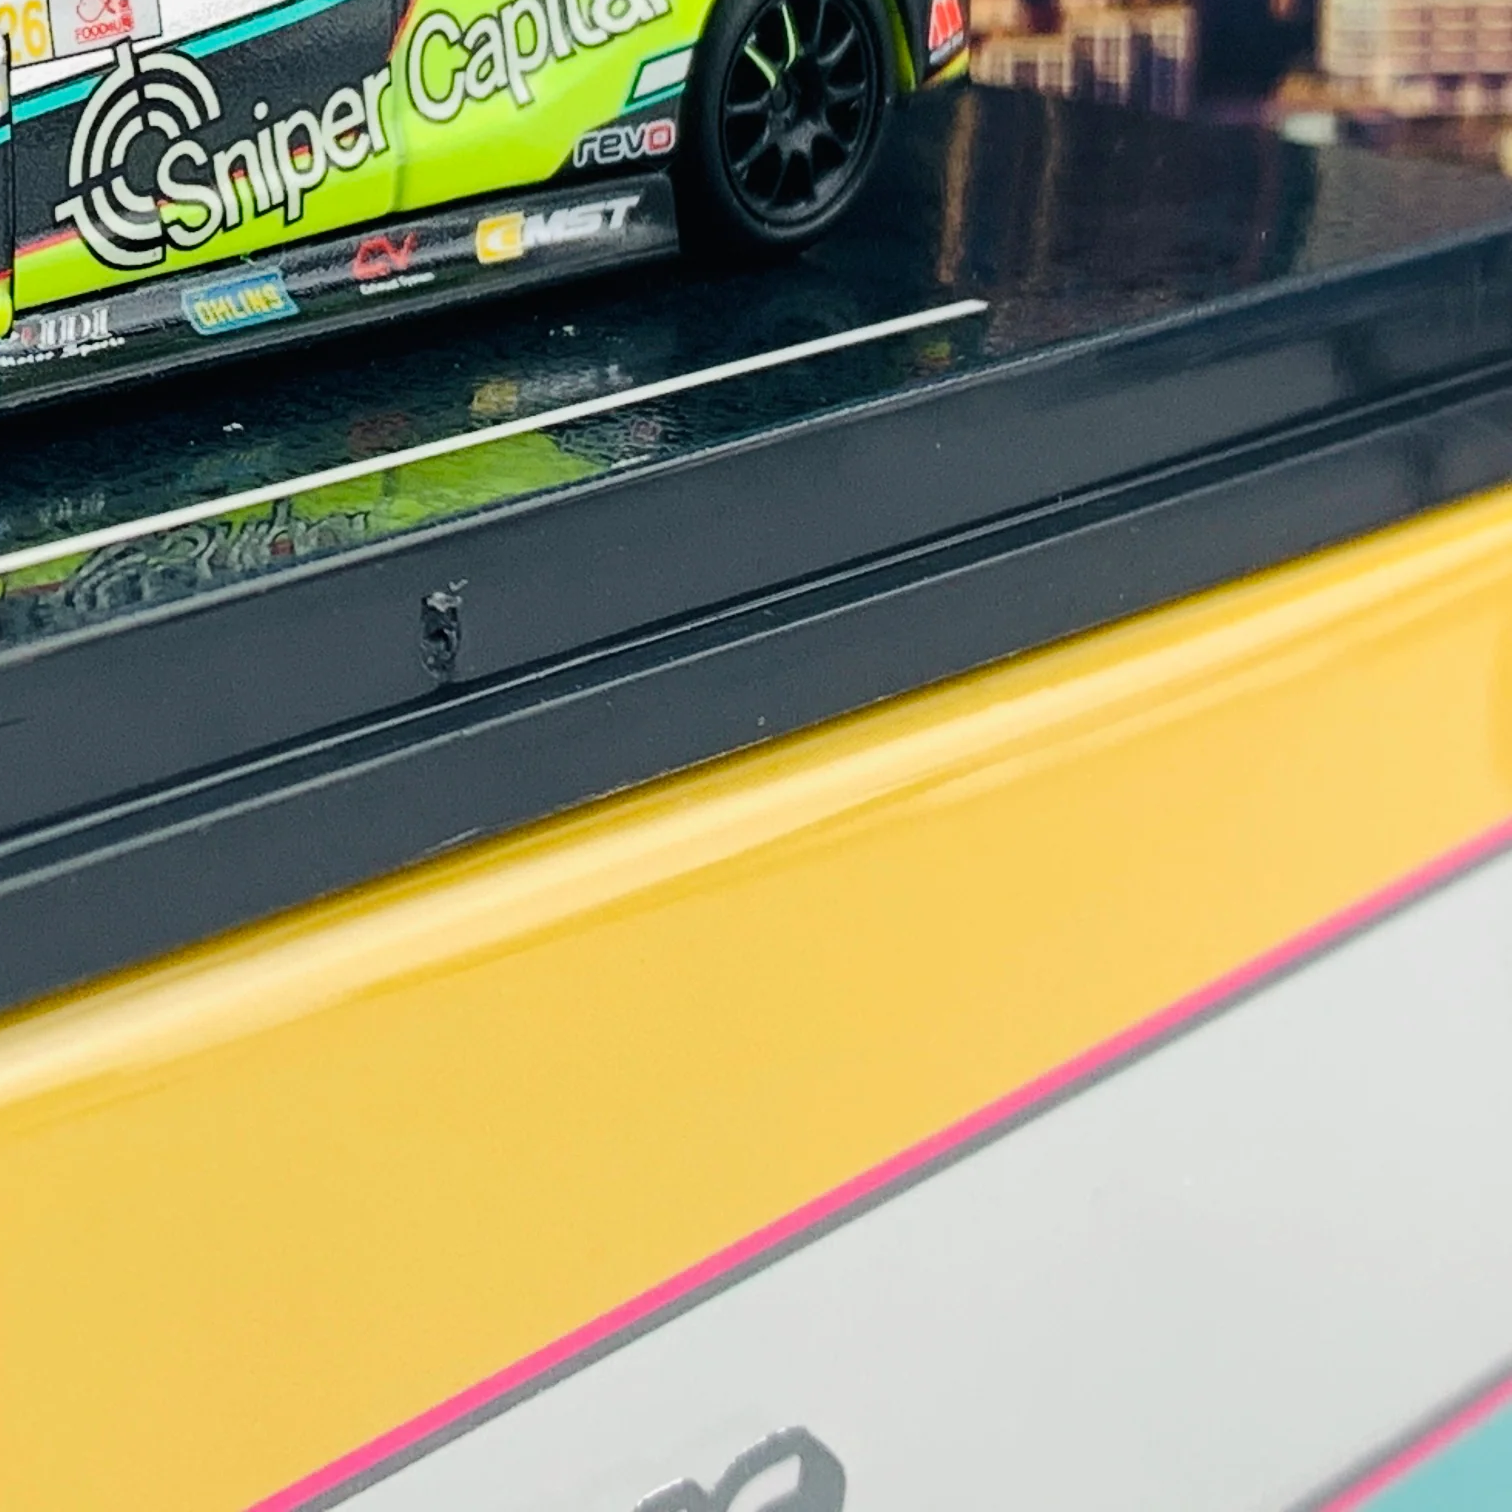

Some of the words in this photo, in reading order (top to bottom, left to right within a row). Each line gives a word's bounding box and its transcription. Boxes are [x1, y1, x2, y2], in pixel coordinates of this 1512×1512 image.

[157, 67, 394, 250] Sniper
[572, 118, 678, 168] revo
[522, 194, 640, 247] MST
